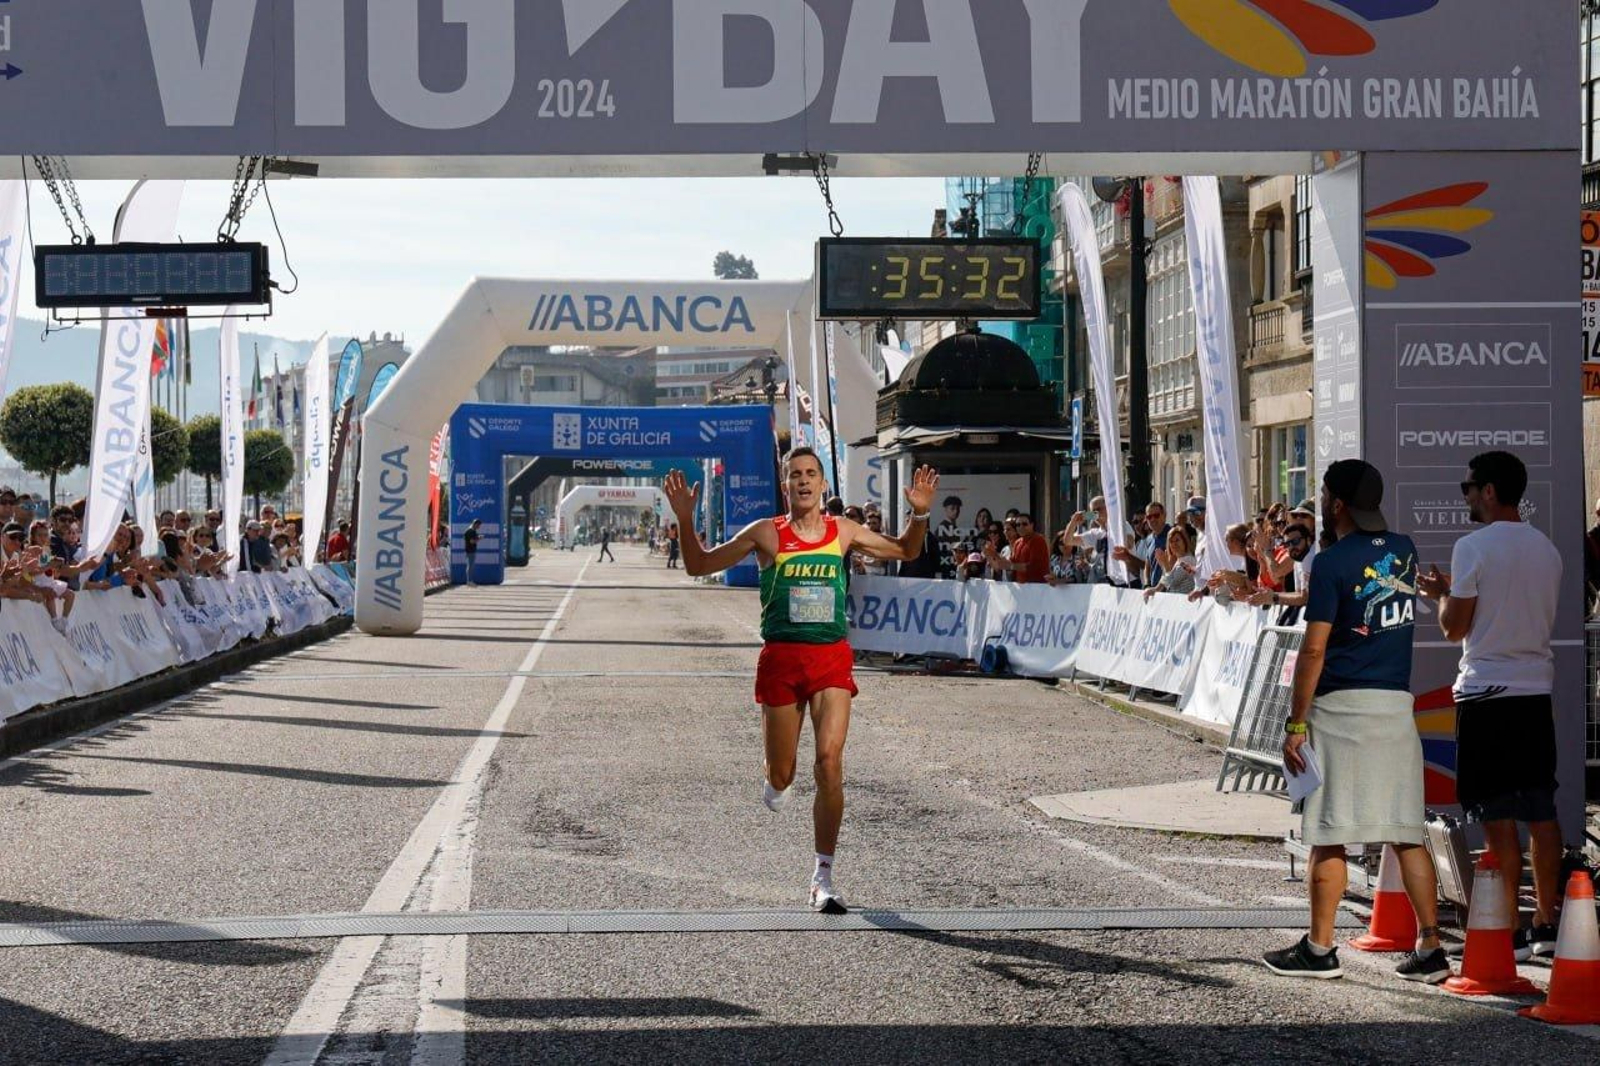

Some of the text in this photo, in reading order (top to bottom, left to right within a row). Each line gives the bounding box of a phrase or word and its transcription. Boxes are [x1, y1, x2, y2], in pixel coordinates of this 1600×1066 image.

[538, 79, 615, 118] 2024
[1108, 65, 1540, 119] MEDIO MARATÓN GRAN BAHÍA
[587, 416, 639, 430] XUNTA
[587, 431, 671, 446] DE GALICIA
[1400, 430, 1547, 447] POWERADE
[572, 459, 653, 470] POWERADE
[1413, 511, 1472, 525] VIEIR
[784, 563, 836, 578] BIKILA
[1380, 598, 1415, 628] UA
